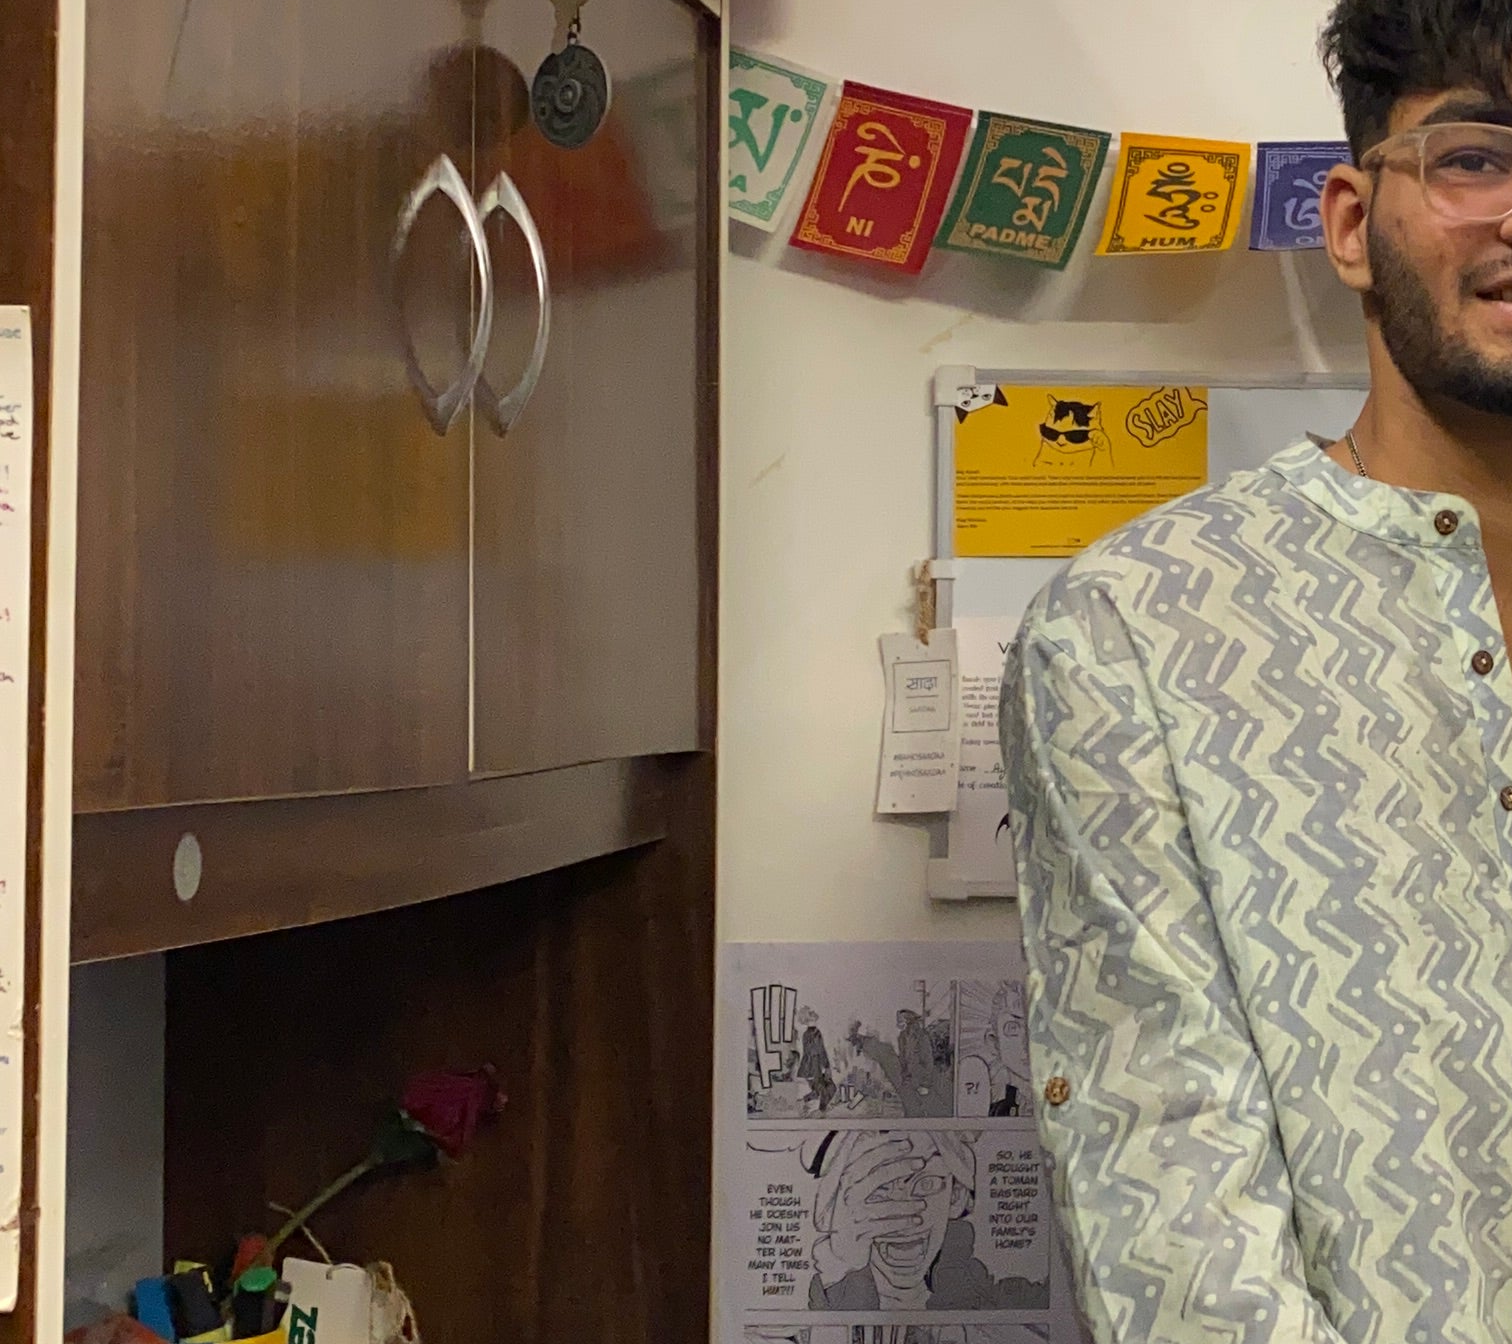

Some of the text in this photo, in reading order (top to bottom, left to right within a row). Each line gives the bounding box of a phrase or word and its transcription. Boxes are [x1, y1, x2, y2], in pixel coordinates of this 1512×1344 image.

[845, 216, 875, 237] NI
[969, 222, 1052, 250] PADME
[1140, 236, 1197, 248] HUM
[1131, 388, 1185, 441] SLAY
[767, 1184, 793, 1194] EVEN
[758, 1197, 801, 1207] THOUGH
[786, 1223, 800, 1232] US
[758, 1236, 772, 1244] NO
[756, 1248, 776, 1257] TER
[748, 1260, 776, 1270] MANY
[772, 1273, 796, 1283] TELL
